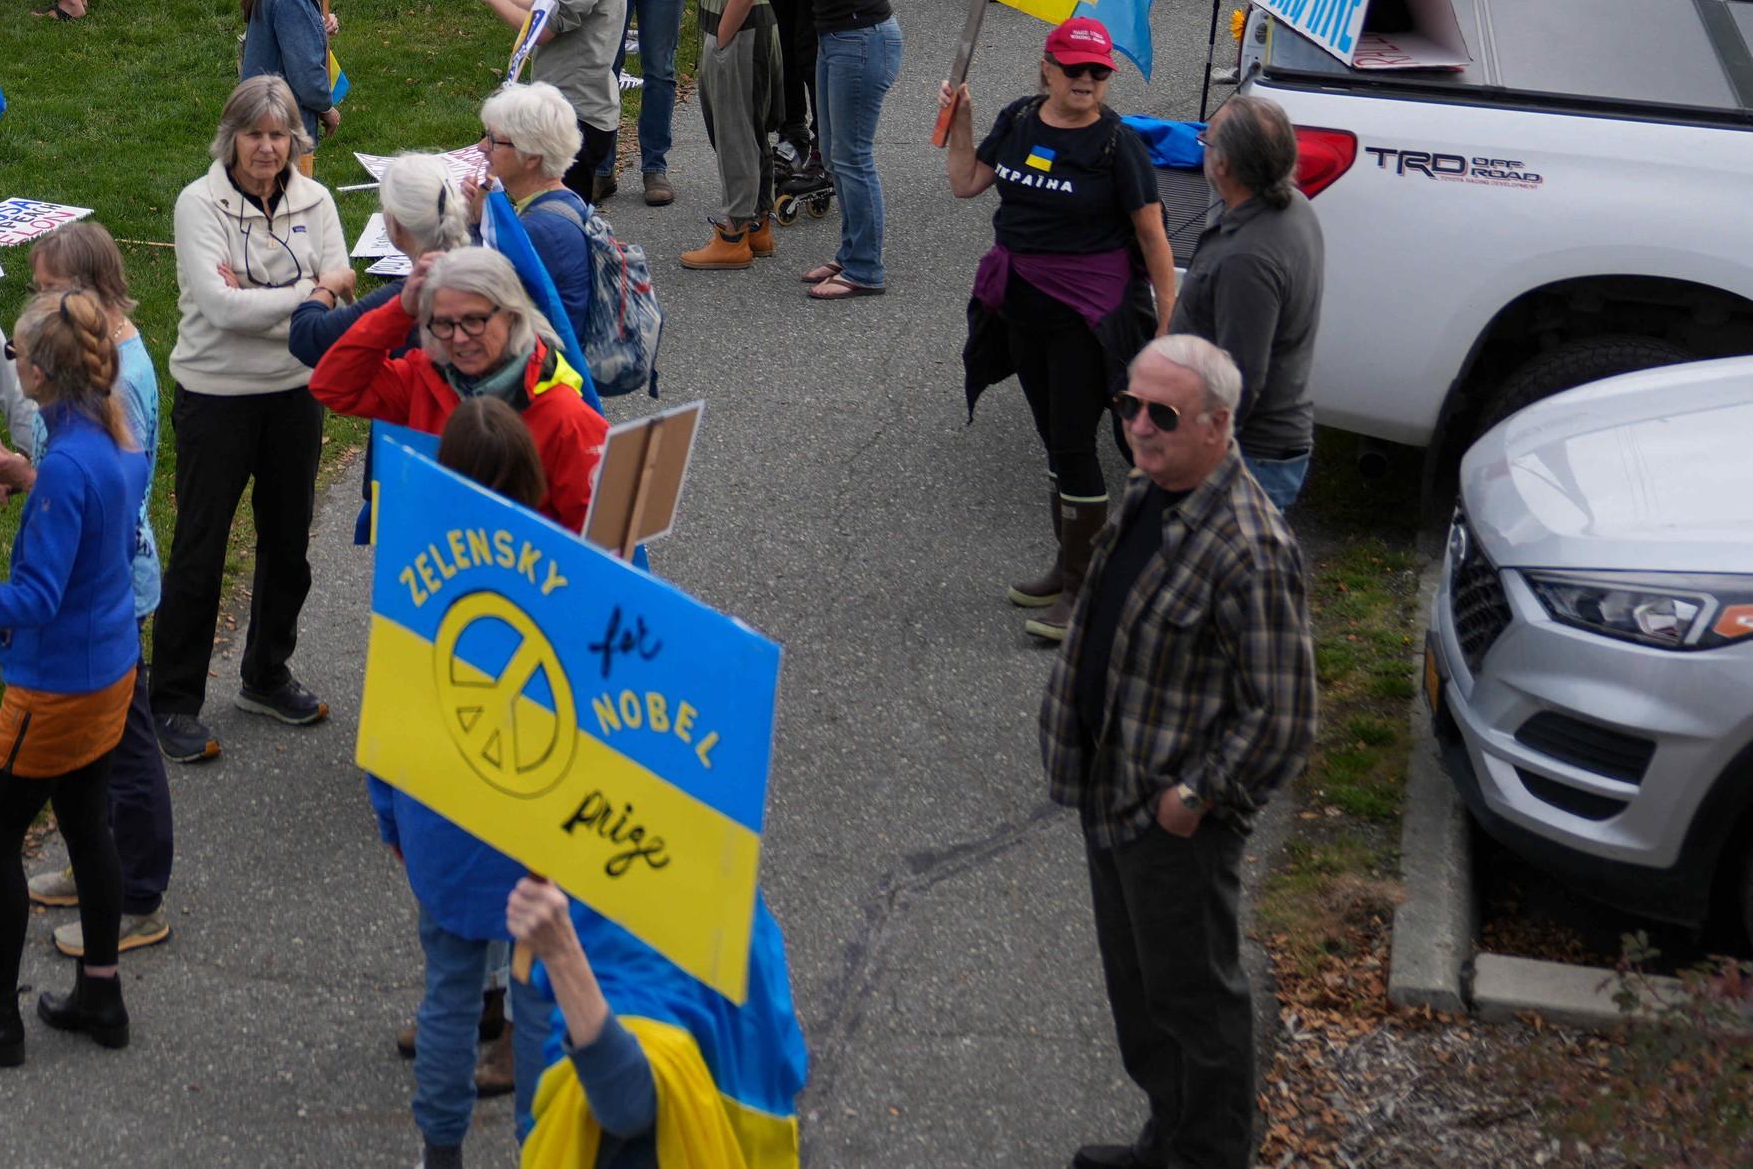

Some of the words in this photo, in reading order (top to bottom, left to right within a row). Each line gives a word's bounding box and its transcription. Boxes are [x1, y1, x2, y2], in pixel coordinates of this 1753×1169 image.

[1365, 146, 1469, 180] TRD
[1472, 157, 1526, 169] OFF
[1440, 175, 1464, 183] TOYOTA
[1491, 181, 1538, 189] DEVELOPMENT
[1472, 168, 1543, 183] ROAD
[399, 527, 570, 607] ZELENSKY
[588, 605, 663, 679] for
[592, 690, 722, 769] NOBEL
[562, 789, 671, 879] prize
